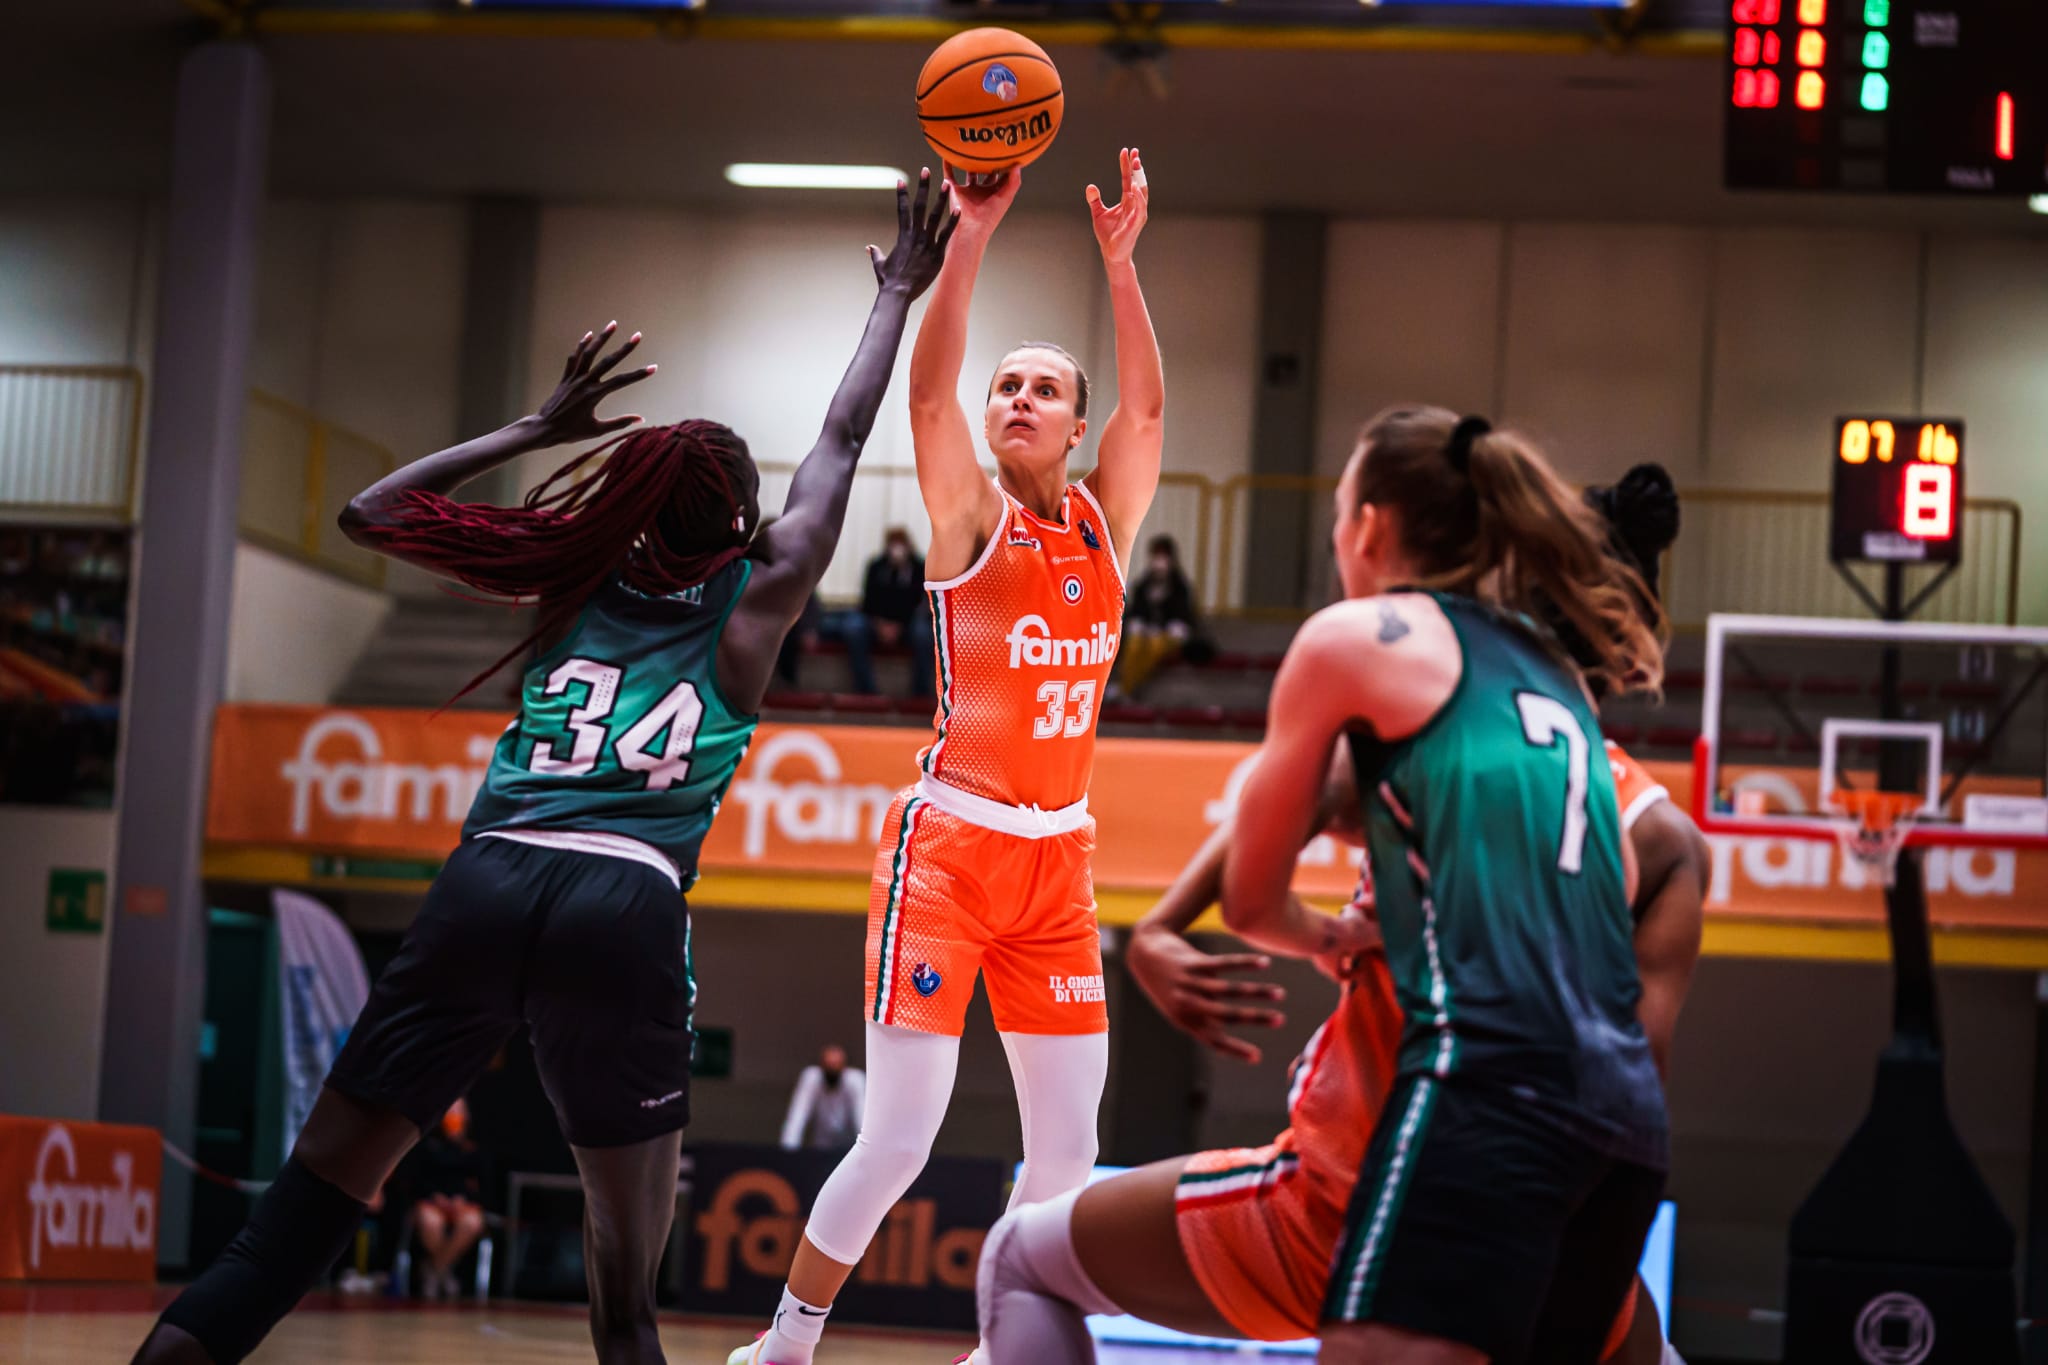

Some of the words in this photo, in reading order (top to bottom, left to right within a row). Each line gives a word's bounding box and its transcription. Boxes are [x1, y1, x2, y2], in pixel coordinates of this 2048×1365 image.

[958, 110, 1053, 146] Wilson
[1903, 463, 1954, 539] 8
[1005, 614, 1118, 668] famila
[528, 657, 705, 791] 34
[1033, 680, 1096, 739] 33
[280, 711, 496, 836] fami
[734, 729, 899, 859] fam
[1514, 690, 1590, 876] 7
[1049, 976, 1065, 989] IL
[1055, 989, 1070, 1003] DI
[29, 1123, 155, 1269] famila
[696, 1168, 989, 1292] faila
